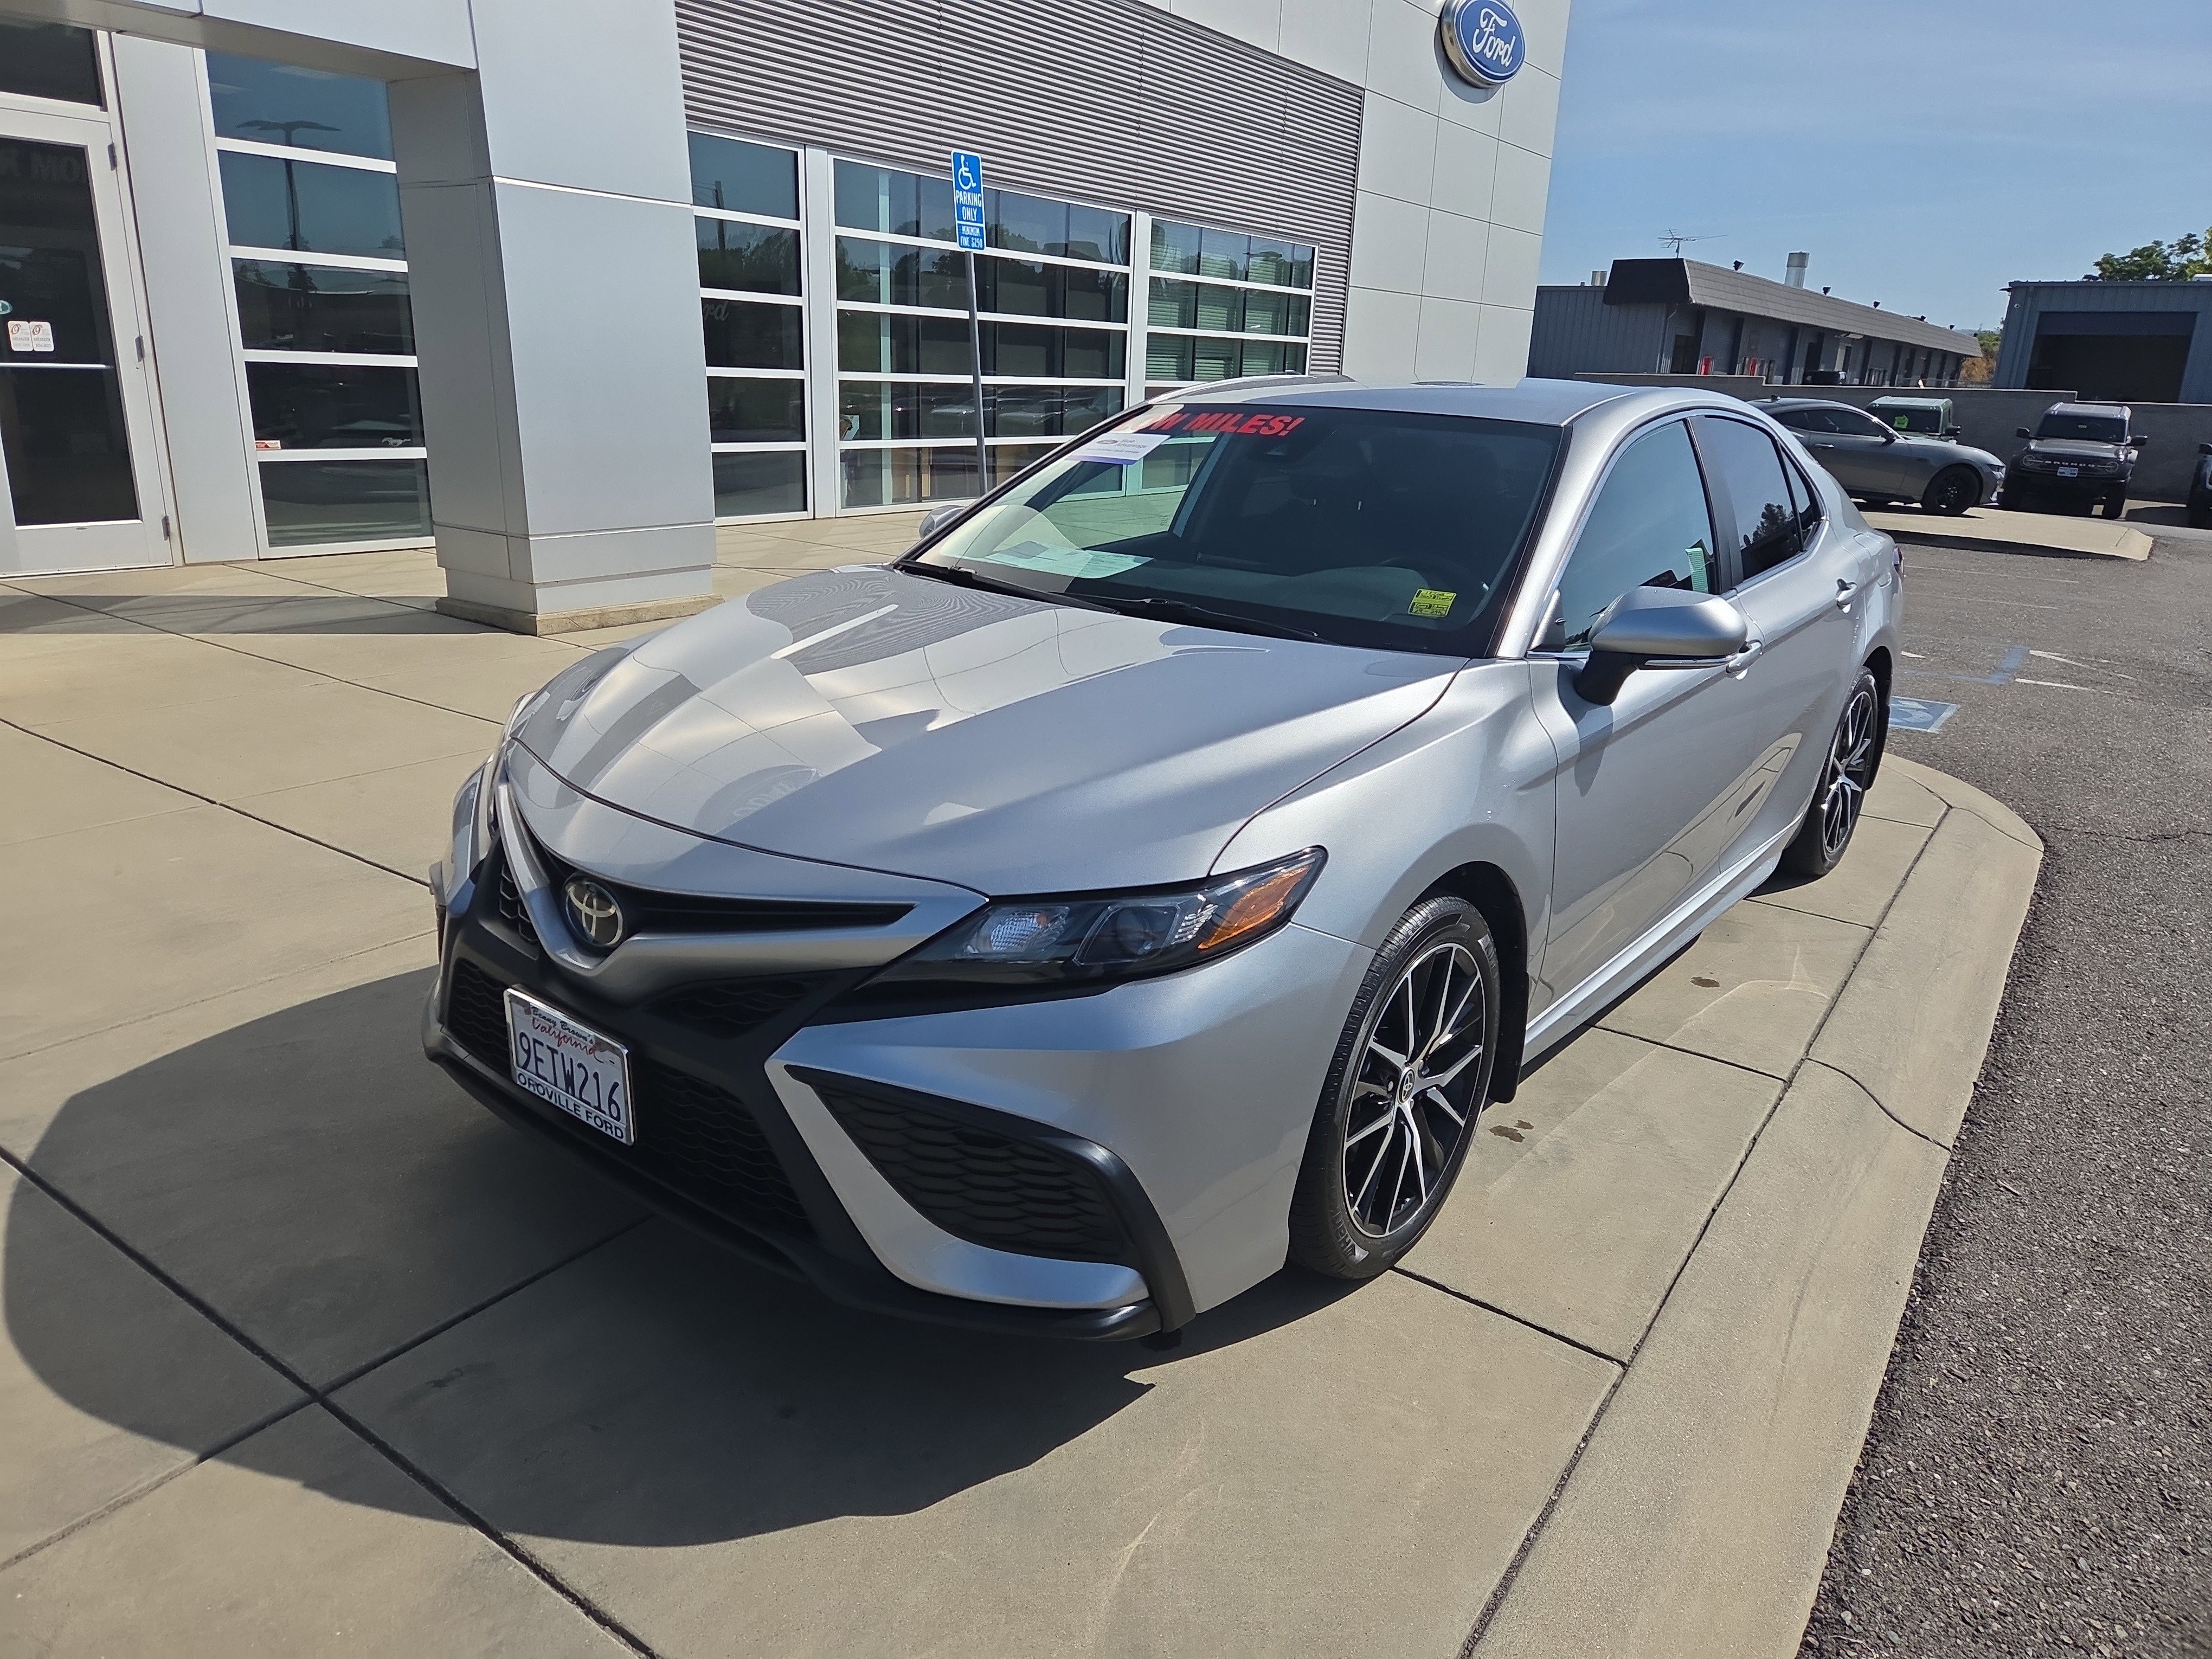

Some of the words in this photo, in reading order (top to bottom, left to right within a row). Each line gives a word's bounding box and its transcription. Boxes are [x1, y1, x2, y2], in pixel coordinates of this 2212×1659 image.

[1472, 8, 1516, 67] Ford
[955, 190, 982, 207] PARKING
[962, 206, 977, 221] ONLY
[971, 237, 983, 248] $250
[1182, 413, 1306, 436] MILES!
[532, 1017, 605, 1064] California
[560, 1020, 594, 1045] Brown's
[518, 1032, 621, 1122] 9ETW216
[518, 1072, 582, 1118] OROVILLE
[585, 1109, 625, 1140] FORD
